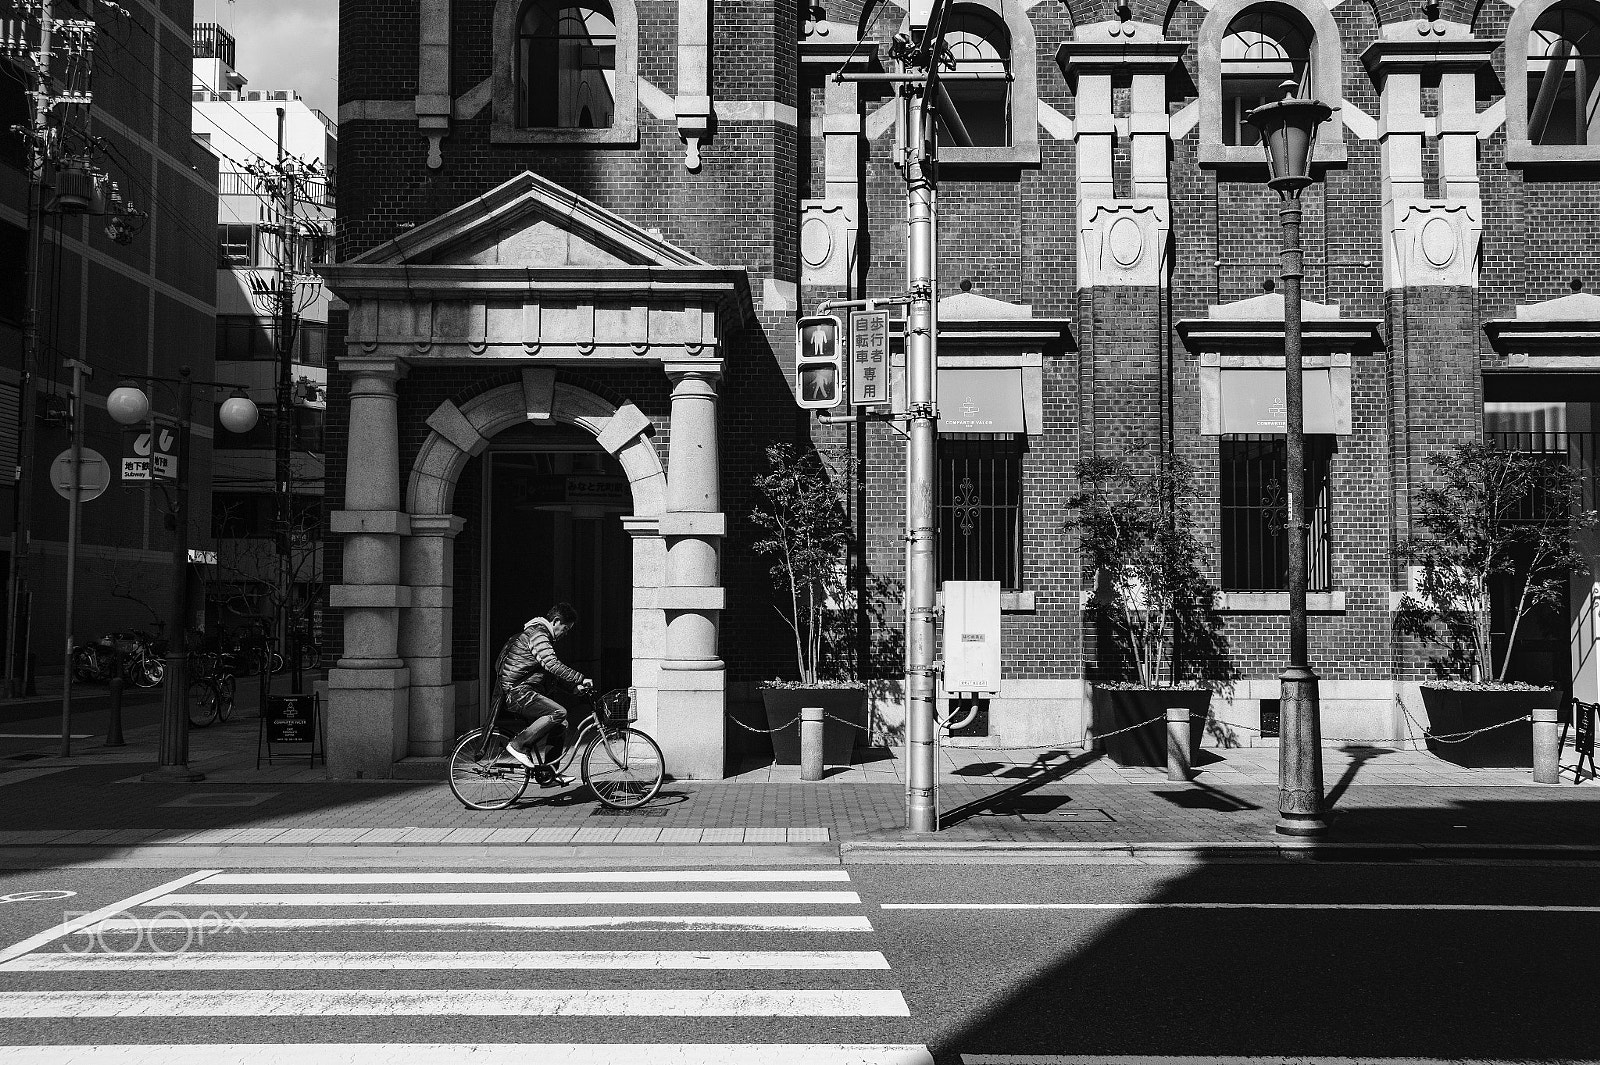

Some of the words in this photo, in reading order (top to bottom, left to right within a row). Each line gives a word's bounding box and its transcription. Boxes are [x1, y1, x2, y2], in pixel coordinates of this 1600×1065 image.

[855, 317, 869, 364] 自転車
[870, 316, 885, 363] 歩行者
[863, 367, 877, 399] 専用
